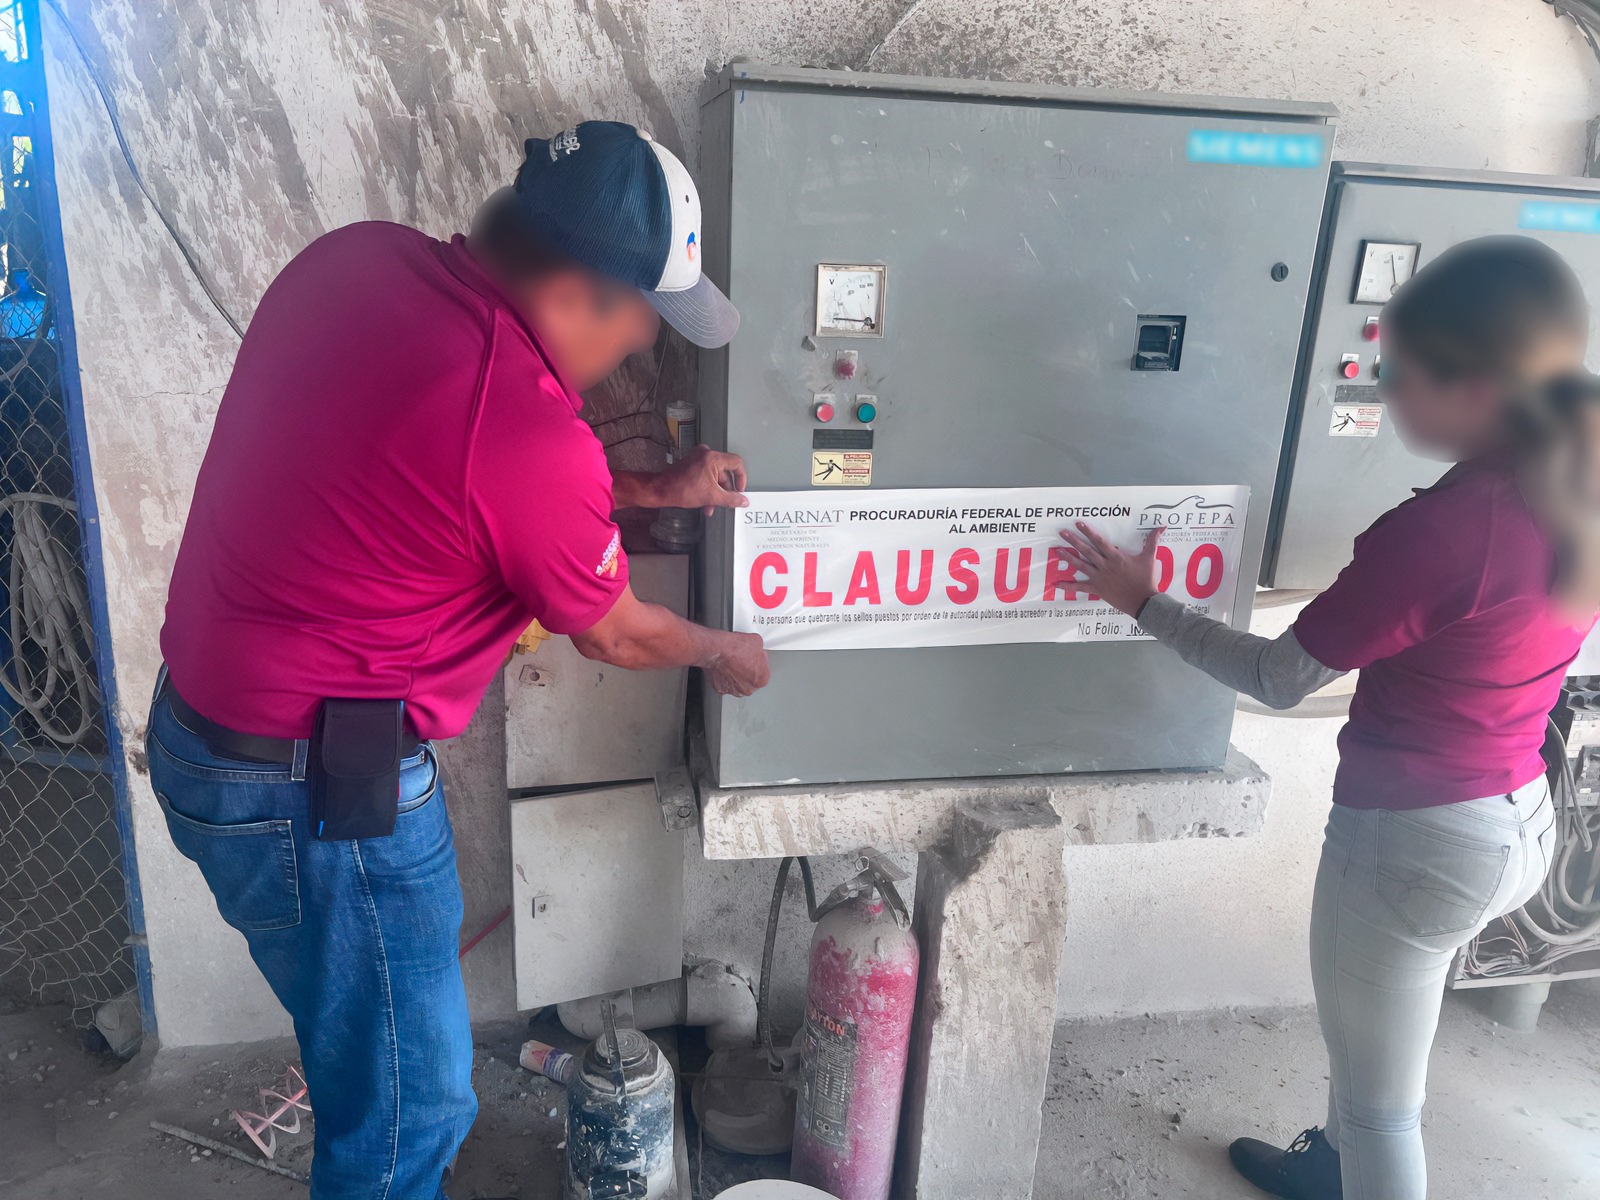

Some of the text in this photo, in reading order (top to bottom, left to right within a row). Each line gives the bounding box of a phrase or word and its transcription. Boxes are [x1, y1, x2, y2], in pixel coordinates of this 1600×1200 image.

[744, 510, 844, 524] SEMARNAT
[850, 504, 1131, 521] PROCURADURÍA FEDERAL DE PROTECCIÓN
[1139, 512, 1235, 526] PROFEPA
[948, 522, 1036, 534] AL AMBIENTE
[753, 614, 757, 623] A
[767, 615, 792, 626] persona
[795, 615, 806, 625] que
[808, 613, 840, 625] quebrante
[854, 612, 872, 622] sellos
[875, 612, 900, 623] puestos
[902, 613, 912, 622] por
[914, 611, 931, 621] orden
[933, 611, 941, 619] de
[950, 608, 978, 619] autoridad
[980, 608, 1003, 621] pública
[1020, 608, 1047, 618] acreedor
[1054, 607, 1064, 617] las
[1065, 607, 1094, 617] sanciones
[1096, 607, 1106, 618] que
[1077, 622, 1091, 635] No
[1095, 622, 1122, 635] Folio:
